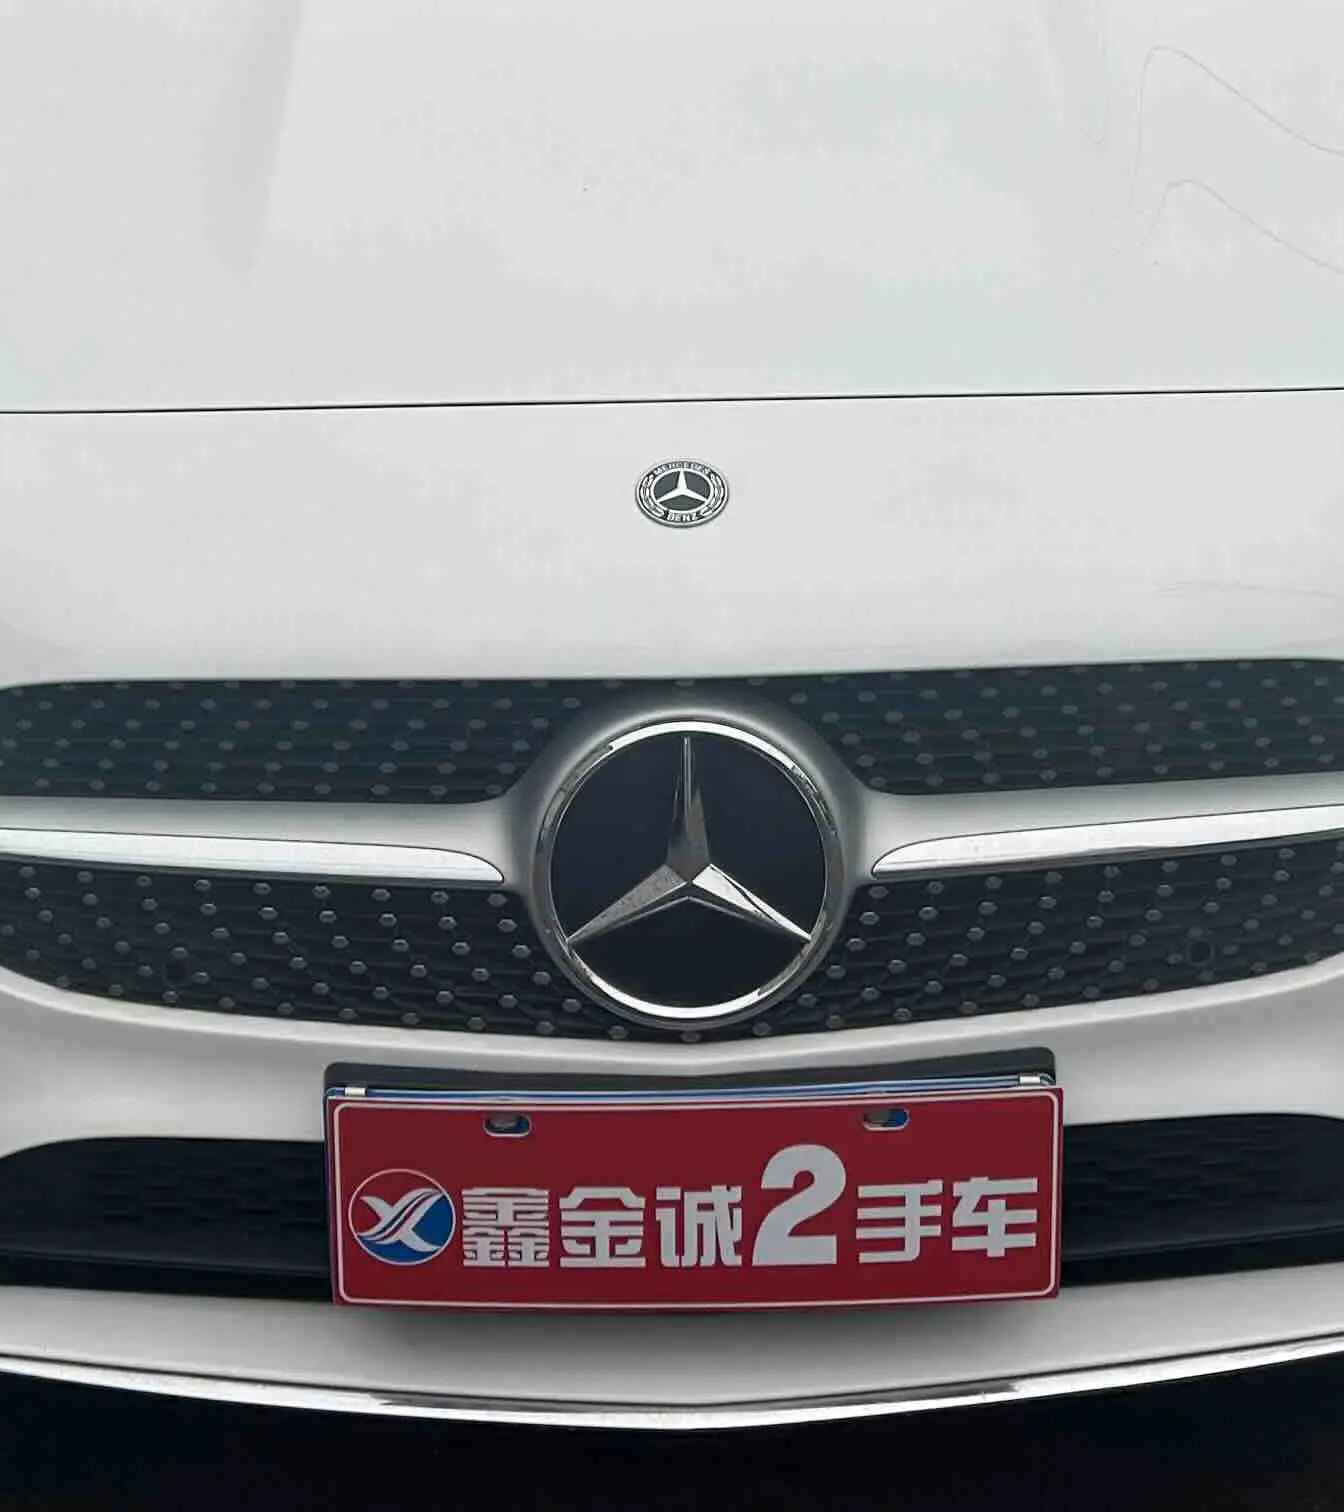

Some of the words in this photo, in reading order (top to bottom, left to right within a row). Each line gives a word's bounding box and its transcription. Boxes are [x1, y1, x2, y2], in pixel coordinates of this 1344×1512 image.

[461, 1144, 1039, 1269] 鑫金诚2手车
